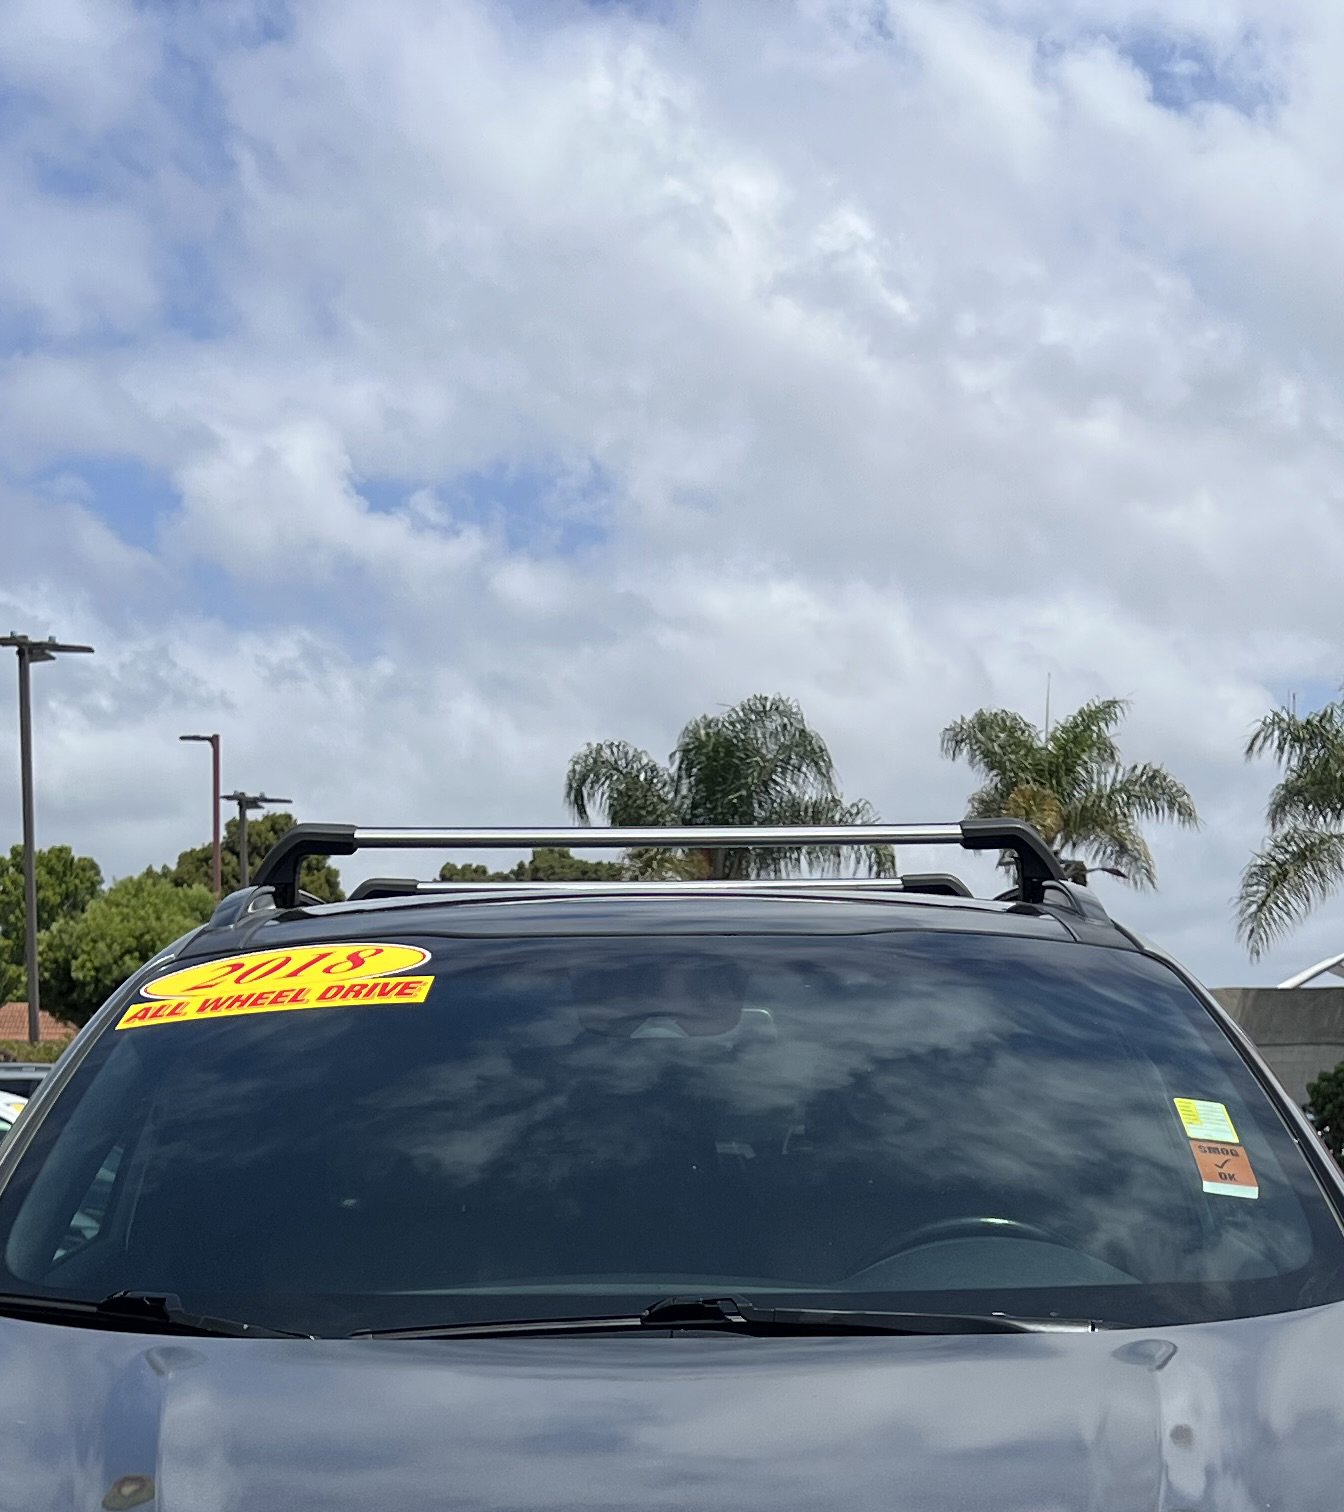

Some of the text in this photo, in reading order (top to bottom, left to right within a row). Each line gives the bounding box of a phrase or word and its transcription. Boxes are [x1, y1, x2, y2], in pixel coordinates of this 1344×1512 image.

[186, 948, 384, 992] 2018
[122, 980, 426, 1025] ALL WHEEL DRIVE
[1197, 1145, 1240, 1158] SMOG
[1218, 1171, 1238, 1182] OK
